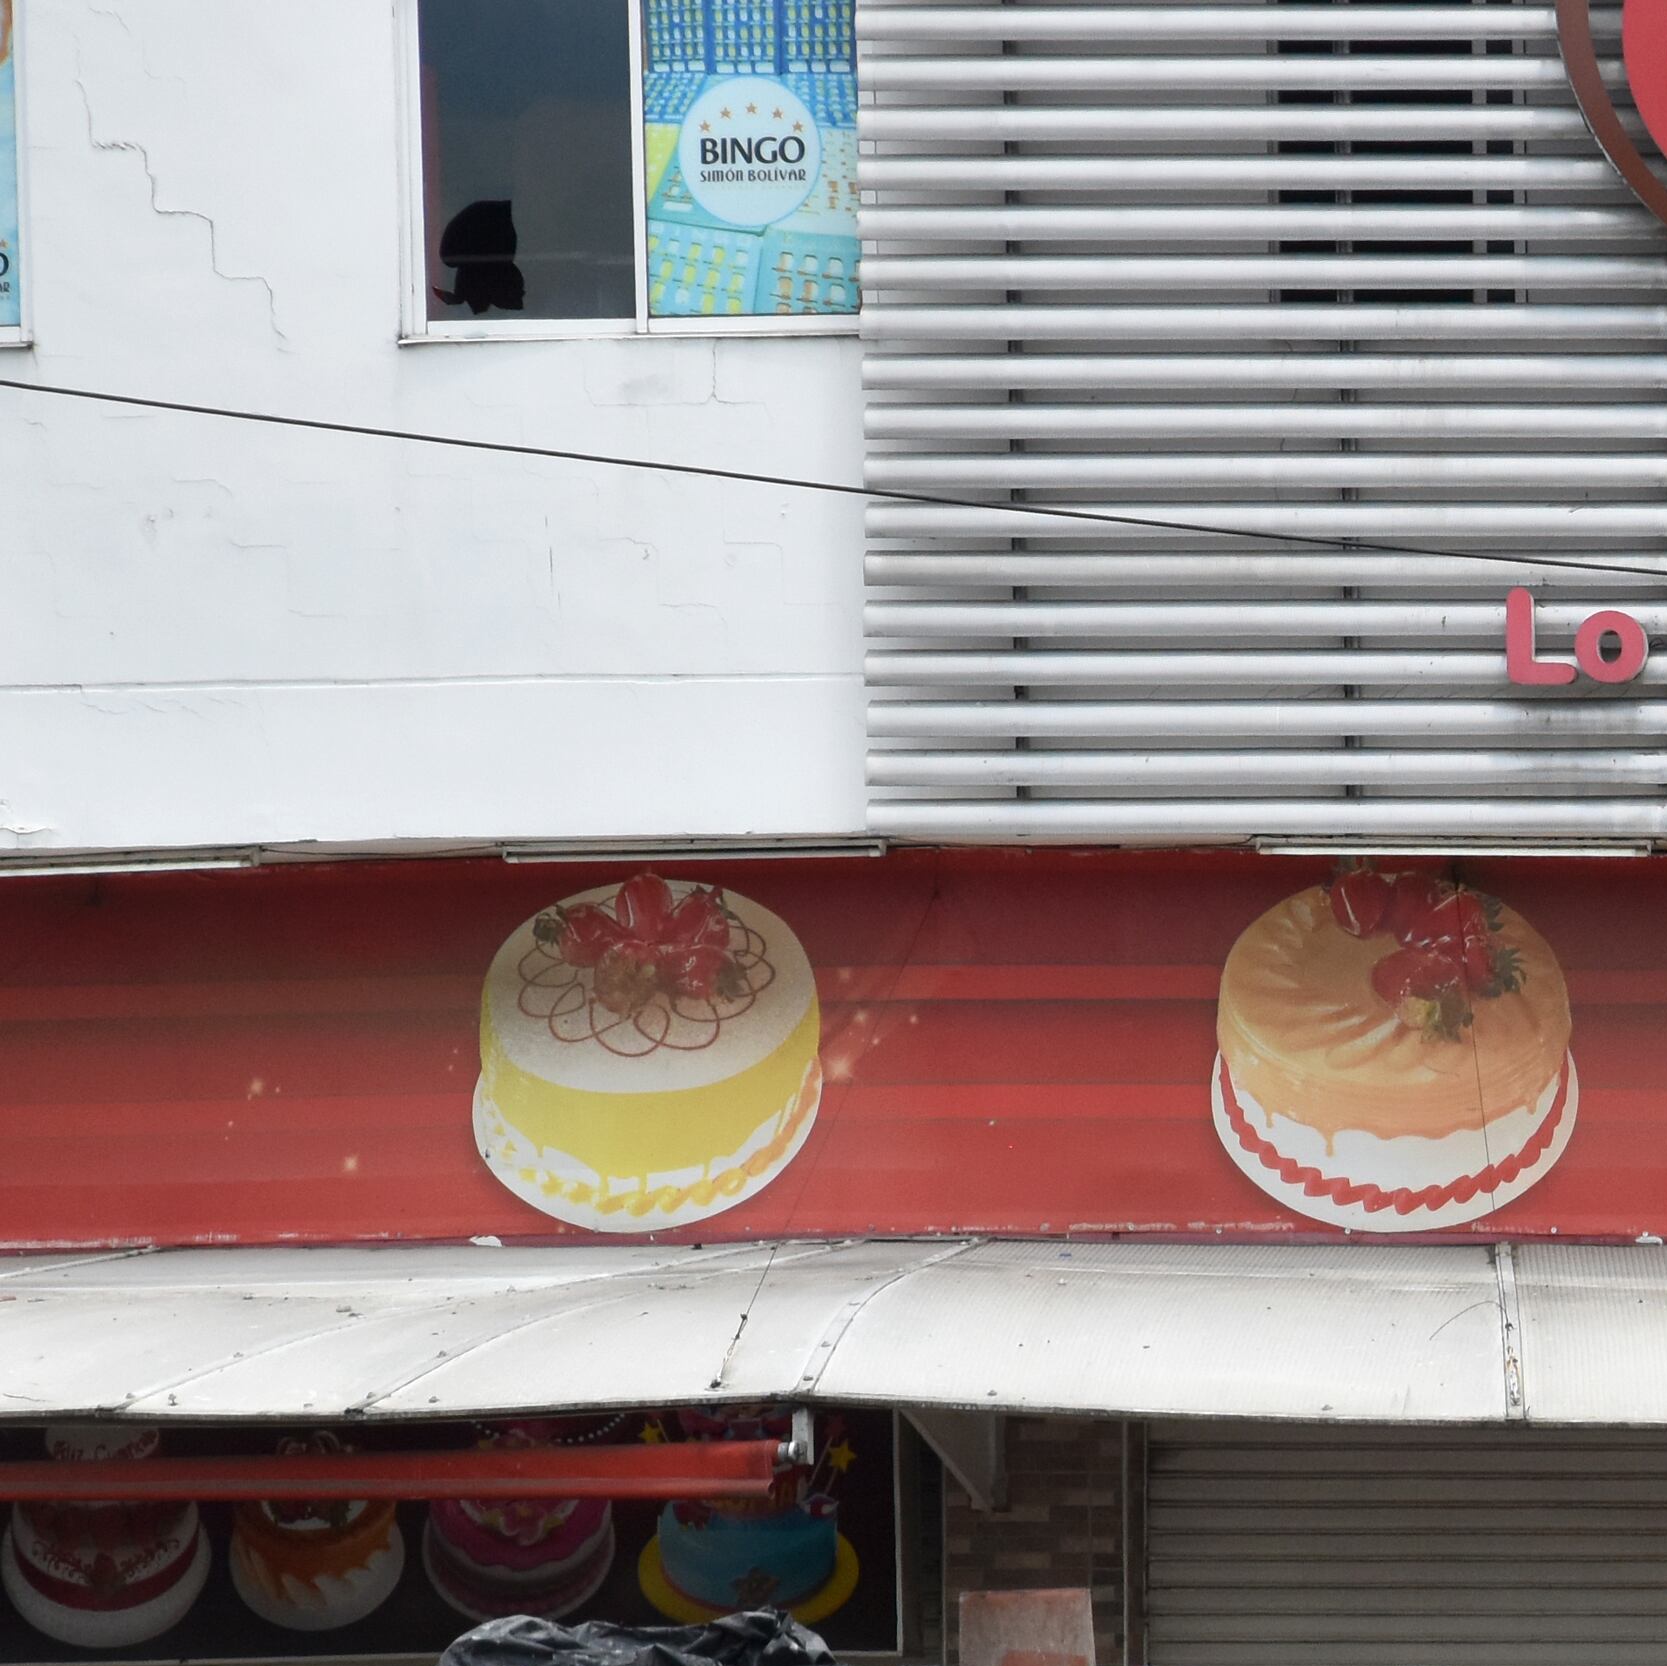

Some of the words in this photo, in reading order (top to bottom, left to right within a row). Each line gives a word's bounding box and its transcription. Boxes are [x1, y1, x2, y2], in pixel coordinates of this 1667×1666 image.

[700, 136, 805, 165] BINGO
[700, 167, 744, 182] SIMÓN
[747, 166, 807, 182] BOLÍVAR
[1504, 588, 1648, 685] Lo
